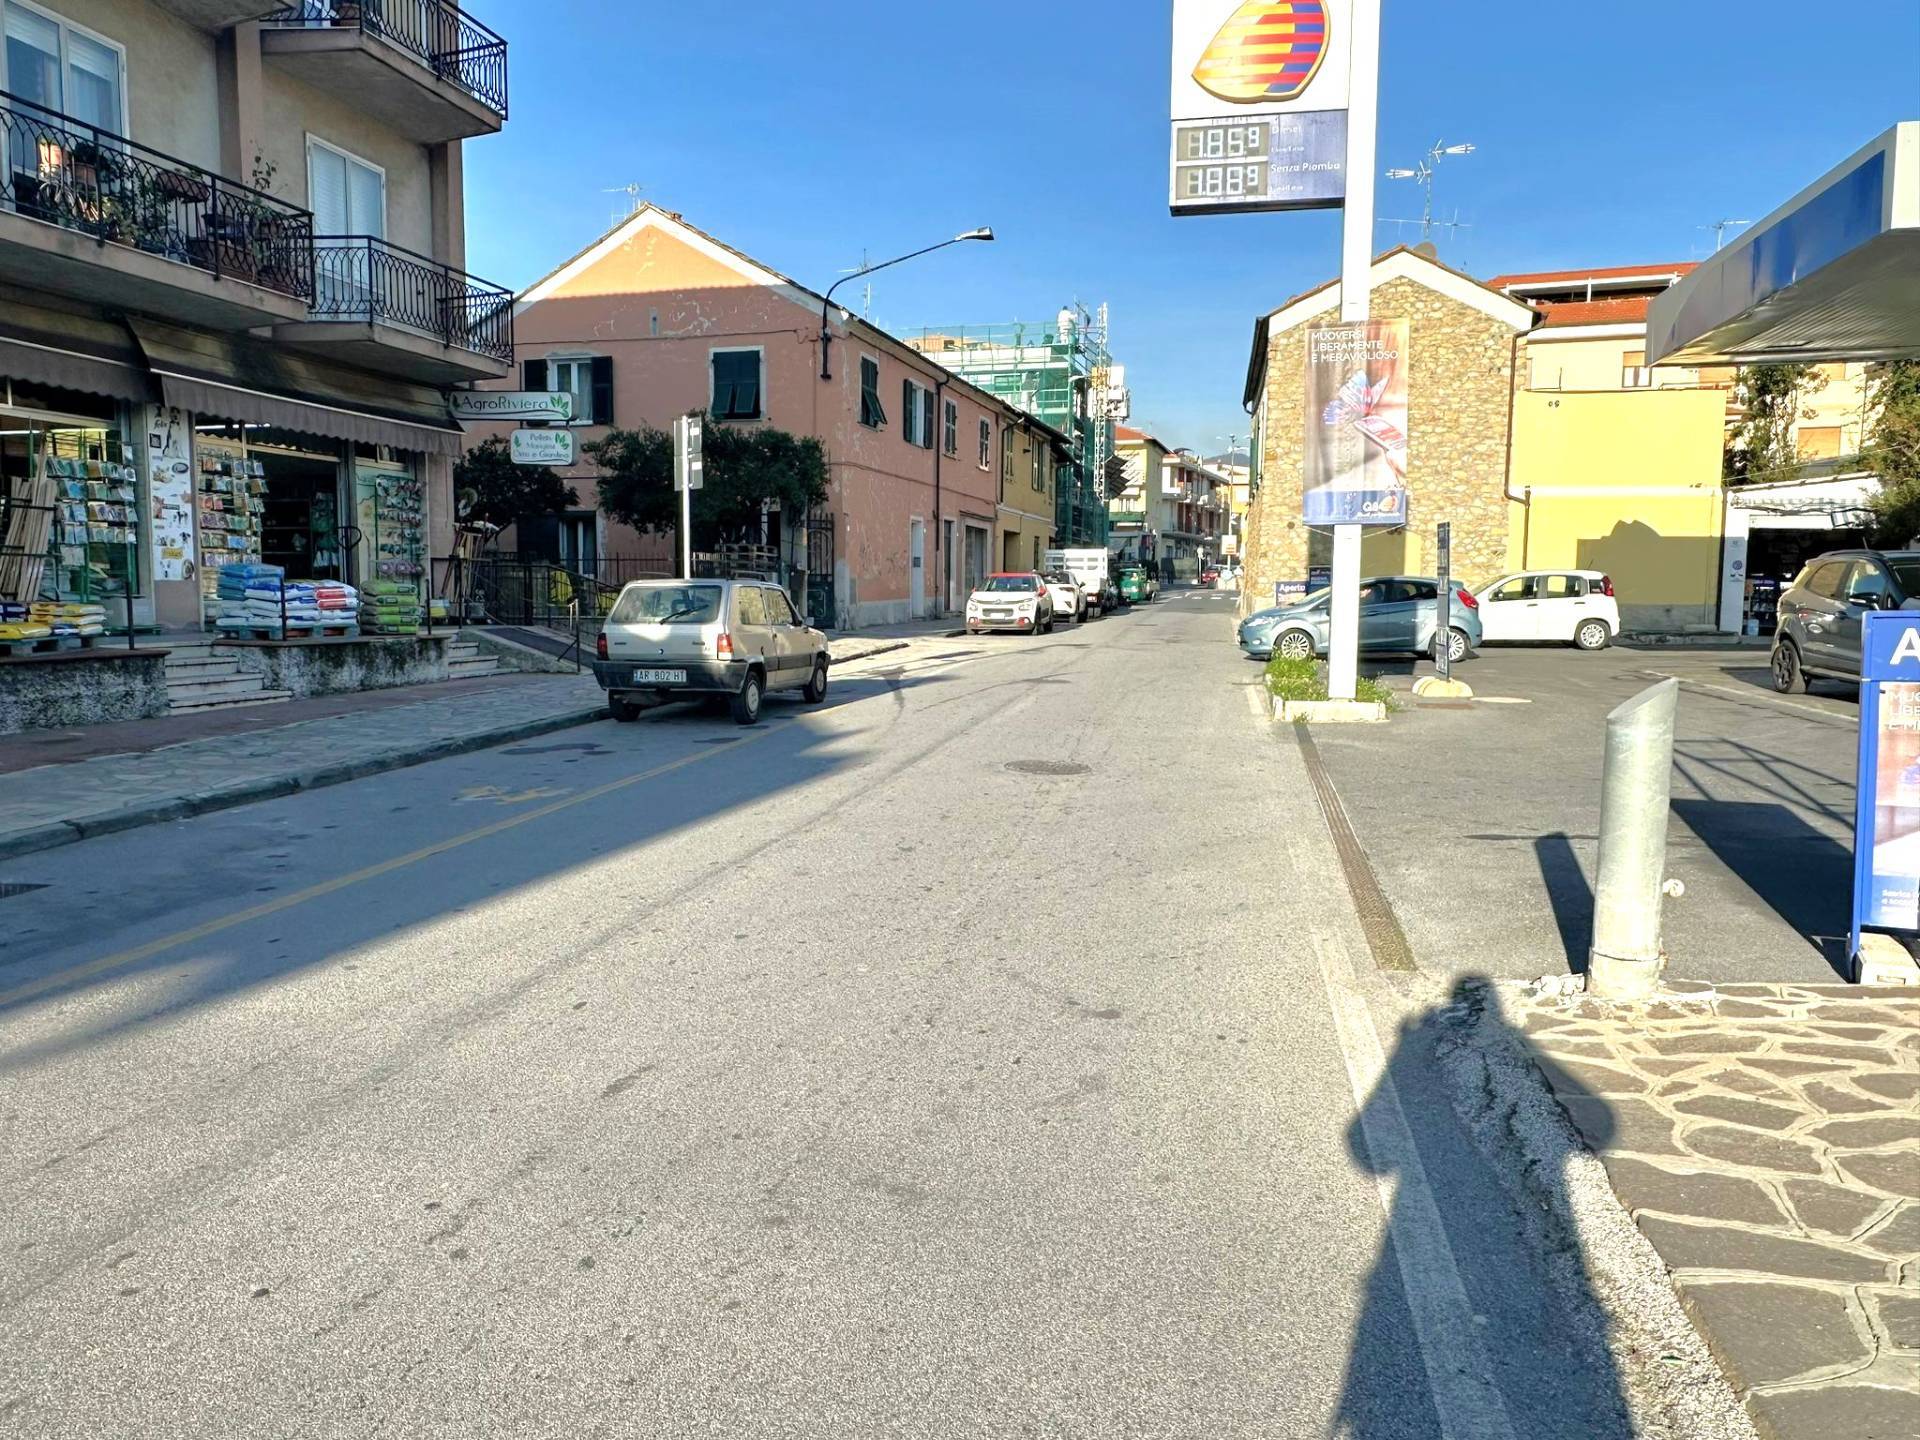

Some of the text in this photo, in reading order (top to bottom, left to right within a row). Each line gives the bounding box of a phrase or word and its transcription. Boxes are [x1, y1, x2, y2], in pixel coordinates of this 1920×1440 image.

[1311, 330, 1365, 341] MUOVERSI
[1311, 341, 1384, 352] LIBERAMENTE
[1321, 350, 1399, 361] MERAVIGLIOSO
[463, 396, 548, 410] AgroRiviera
[1279, 583, 1306, 592] Aperto
[639, 670, 649, 680] AR
[654, 670, 671, 680] 802
